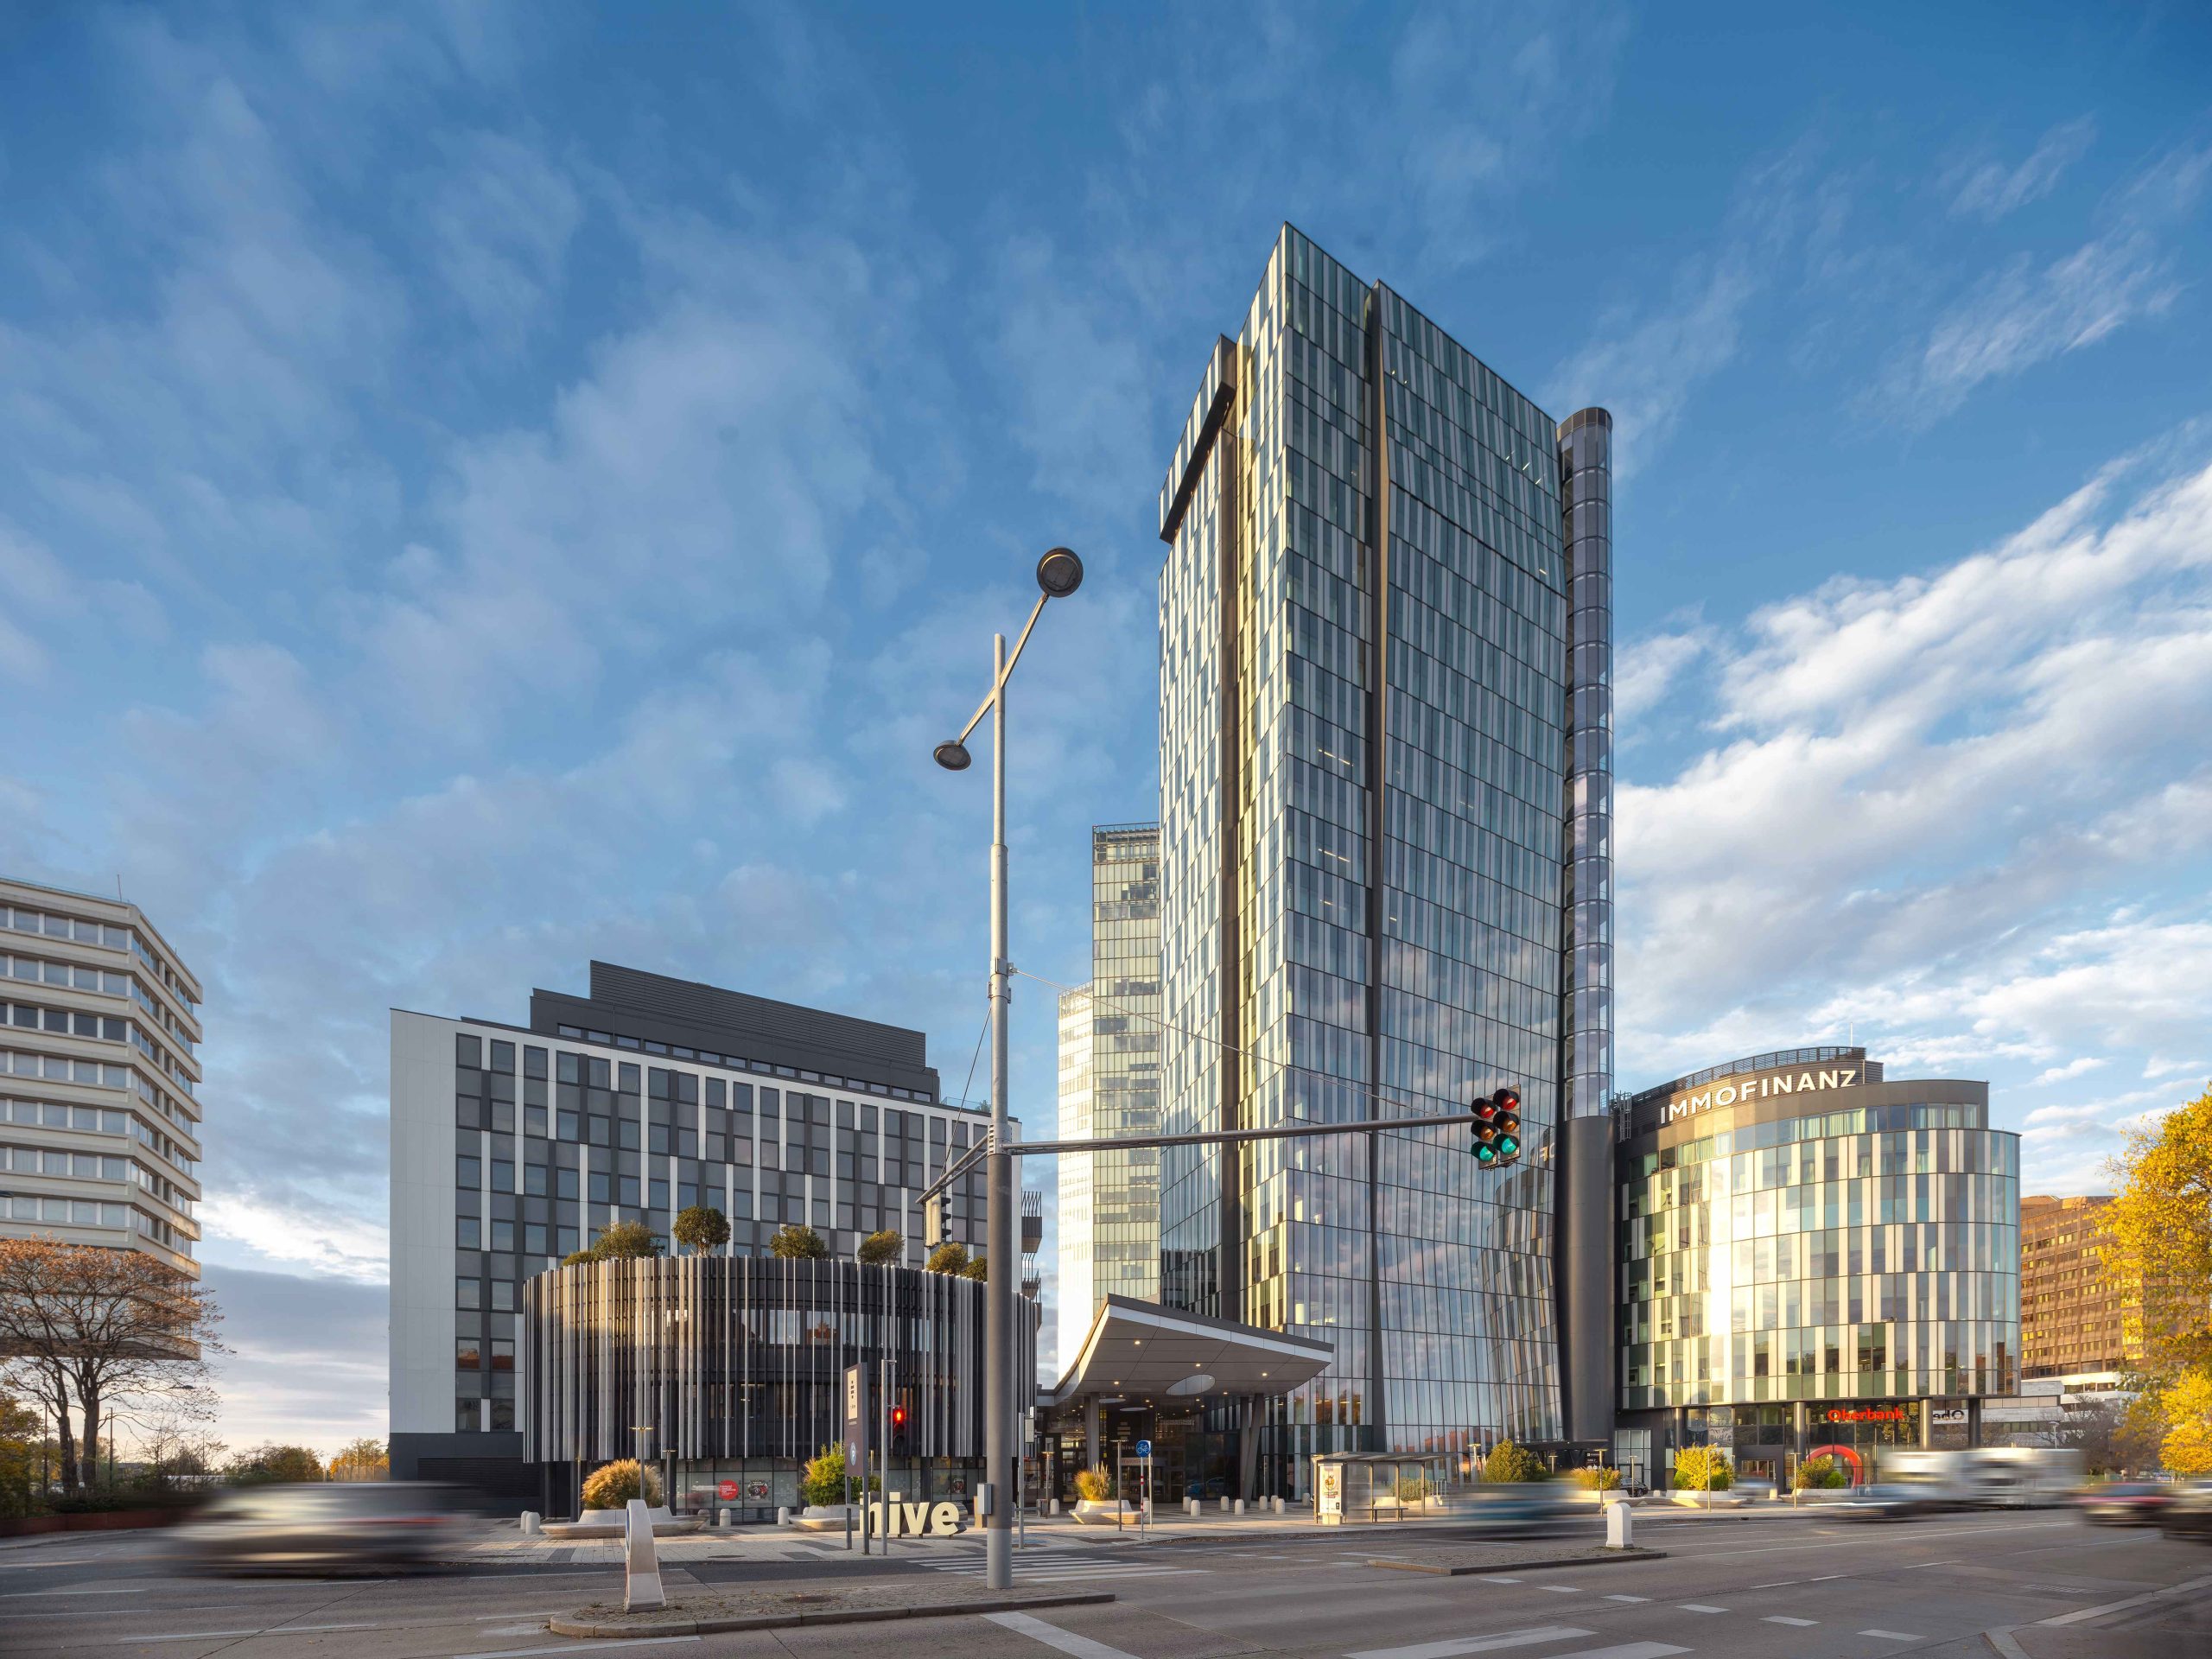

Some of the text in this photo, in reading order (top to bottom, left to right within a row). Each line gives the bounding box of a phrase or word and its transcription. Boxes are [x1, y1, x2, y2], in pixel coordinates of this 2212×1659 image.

[1660, 1070, 1857, 1124] IMMOFINANZ
[1827, 1407, 1904, 1421] Oberbank
[859, 1491, 960, 1535] hive
